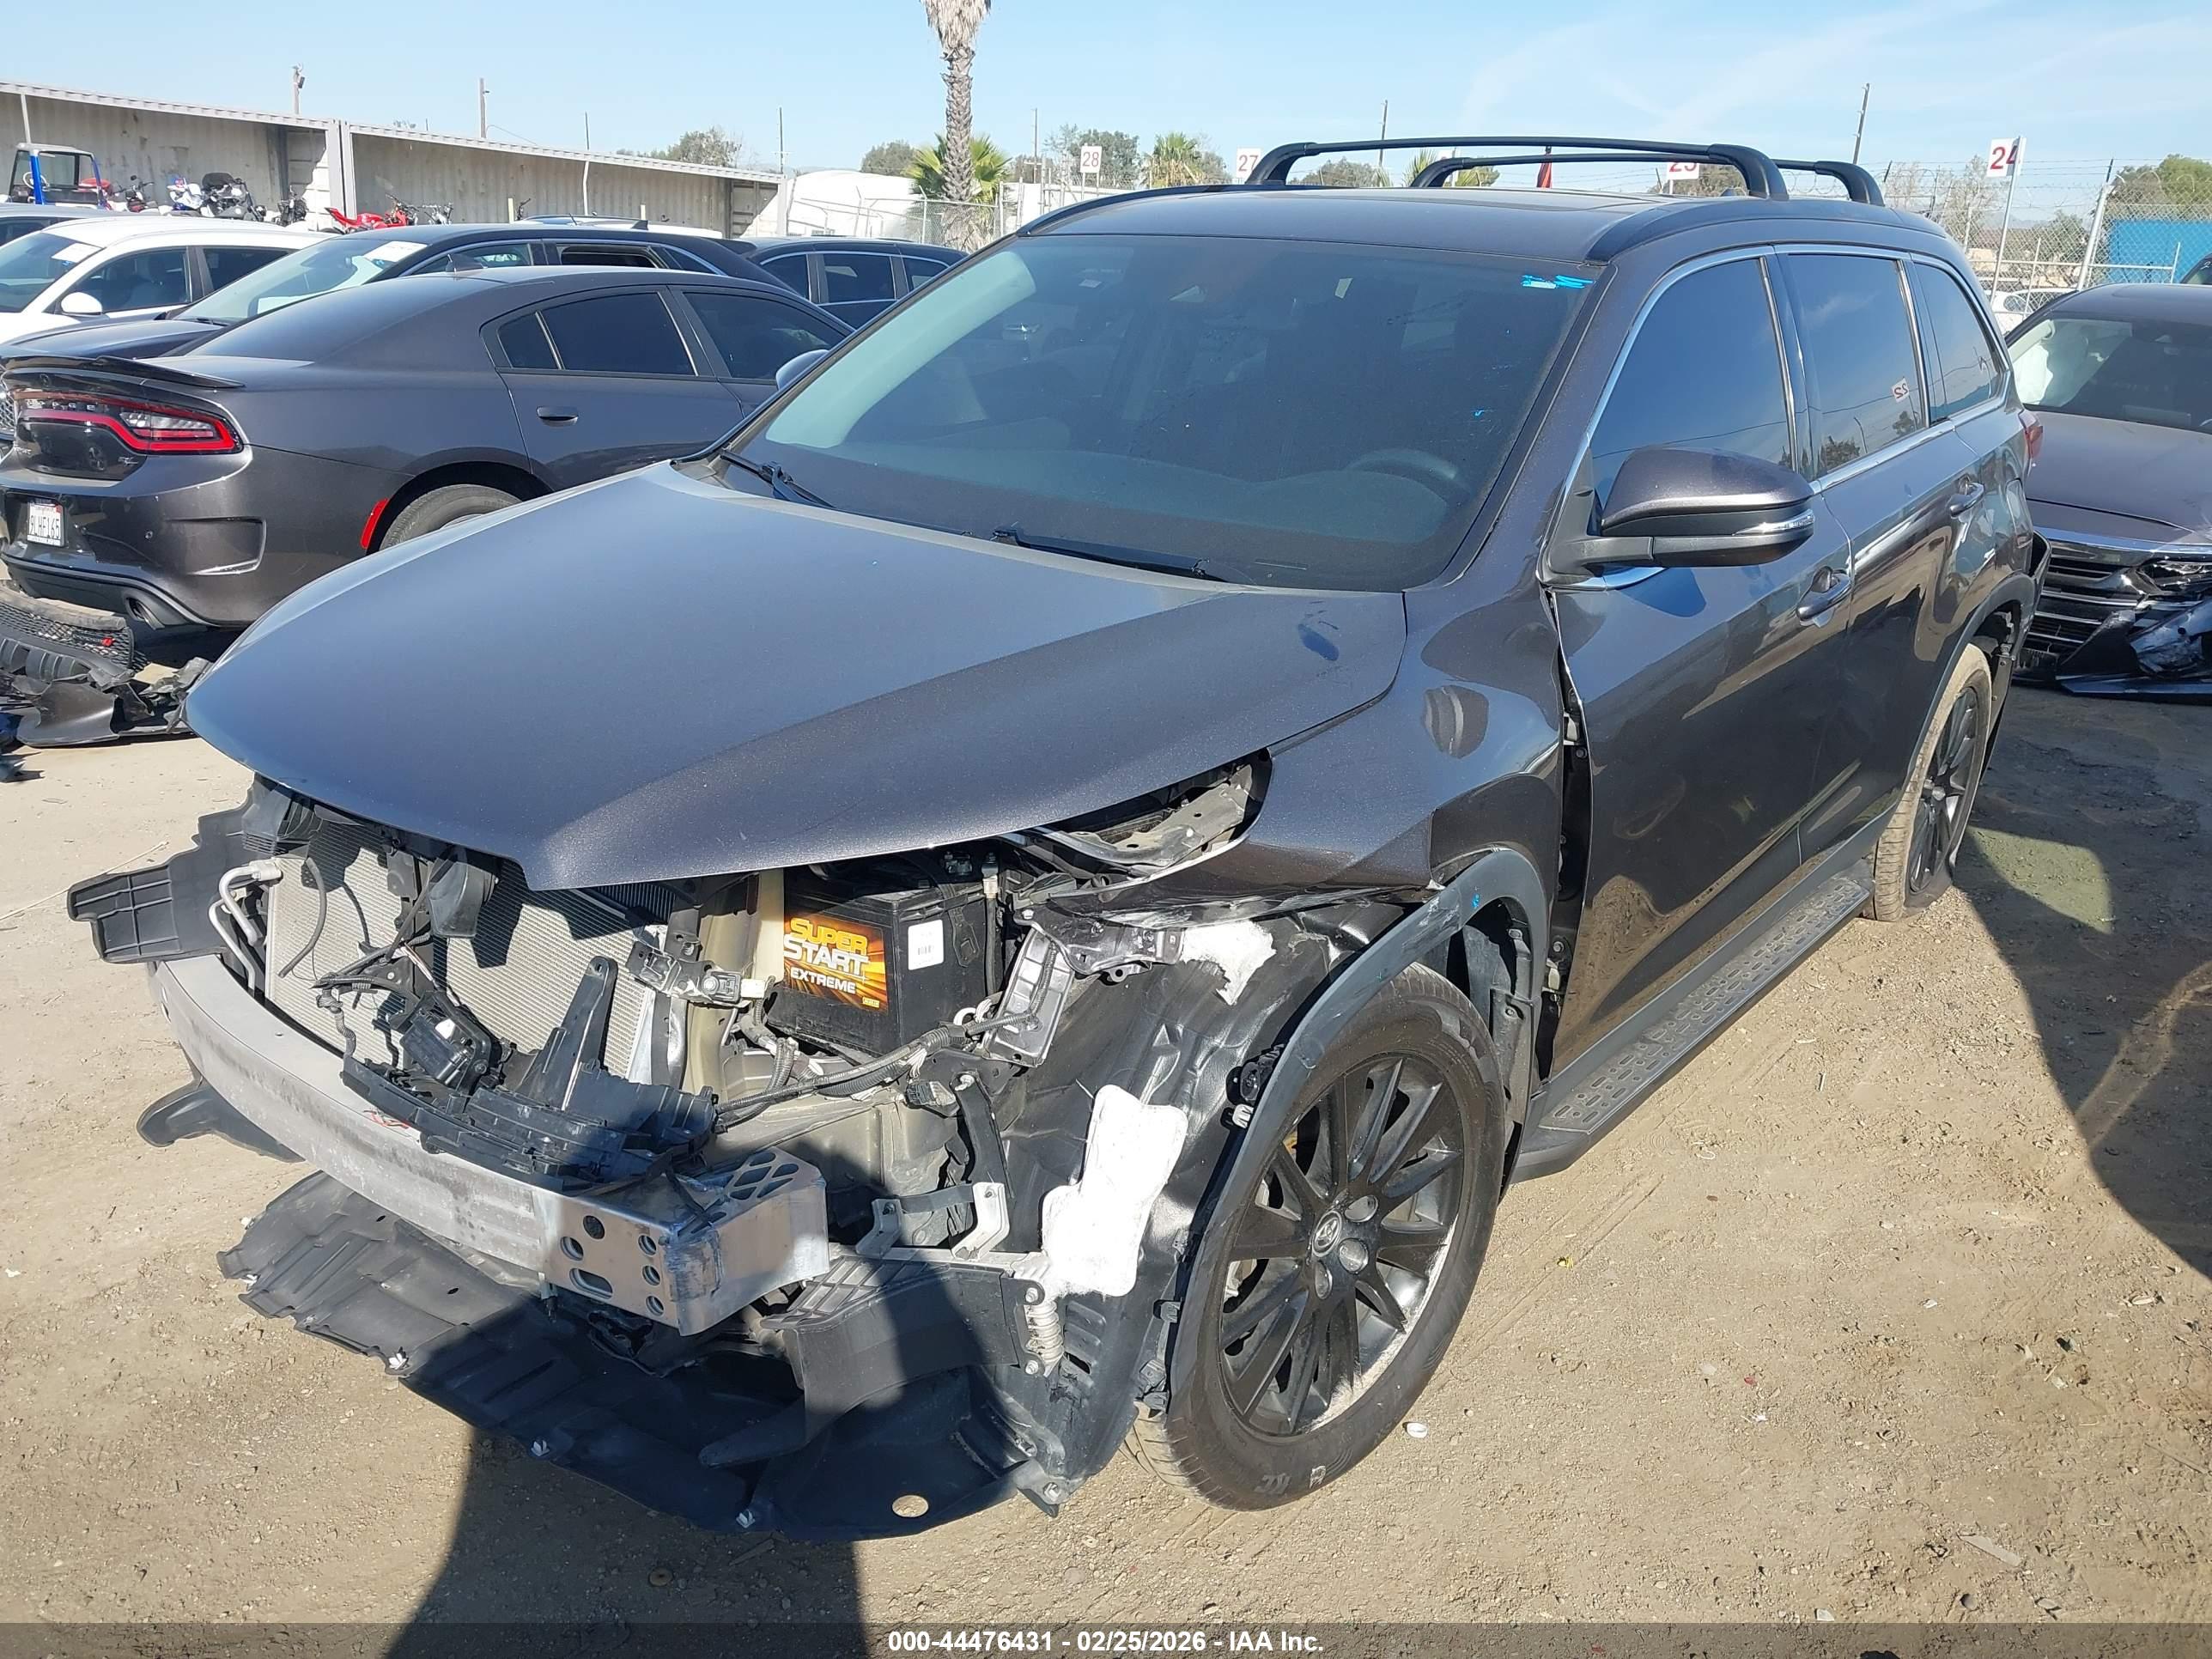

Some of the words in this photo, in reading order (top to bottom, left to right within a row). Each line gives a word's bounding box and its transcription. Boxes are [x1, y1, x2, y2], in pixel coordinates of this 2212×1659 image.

[1082, 151, 1099, 167] 28
[1238, 155, 1259, 172] 27
[1990, 145, 2020, 170] 24
[790, 917, 868, 956] SUPER
[783, 933, 871, 975] START
[790, 966, 857, 994] EXTREME
